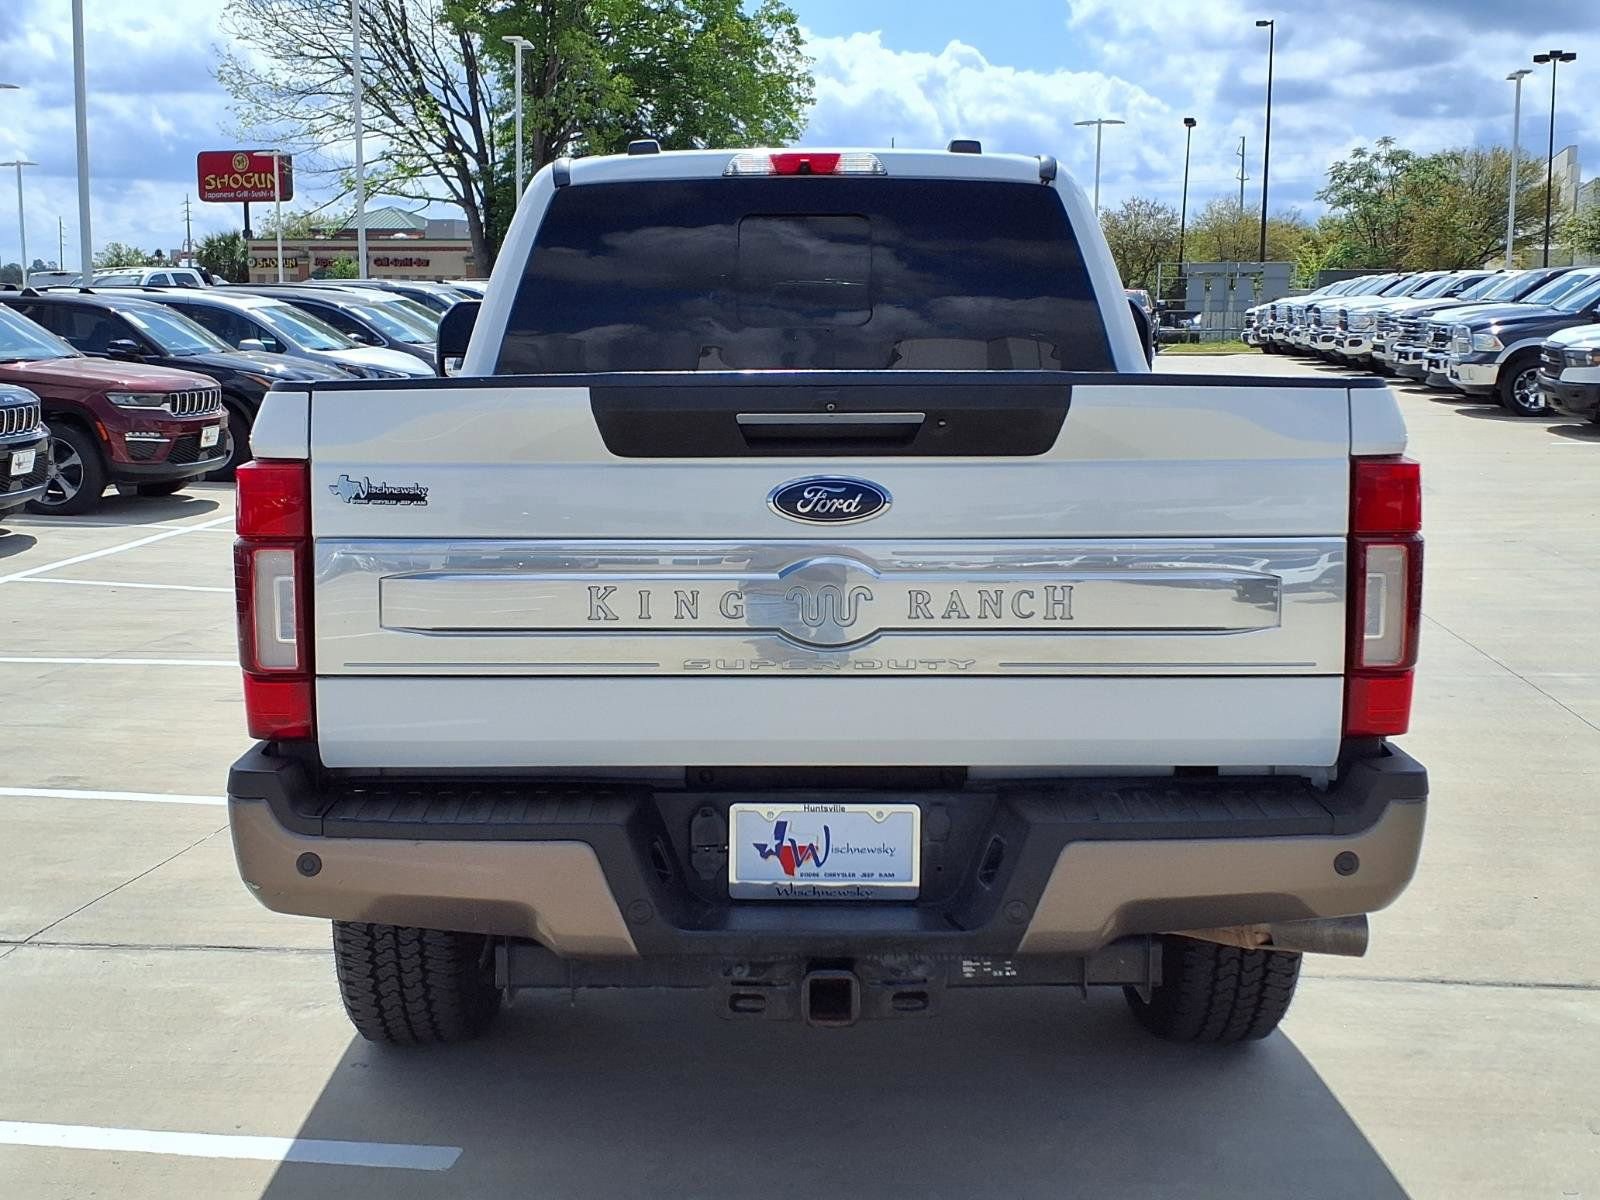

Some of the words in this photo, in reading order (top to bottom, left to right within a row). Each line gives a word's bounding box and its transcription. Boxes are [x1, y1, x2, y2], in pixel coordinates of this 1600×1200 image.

[205, 172, 277, 190] SHOGUN
[205, 191, 235, 199] Japanese
[256, 257, 298, 269] SHOUN
[796, 485, 863, 513] Ford
[587, 586, 745, 620] KING
[908, 585, 1074, 620] RANCH
[683, 659, 841, 671] SUPER
[854, 659, 977, 671] DUTY
[803, 804, 846, 814] Huntsville
[788, 825, 896, 868] Wischnewsky
[775, 882, 873, 898] Wischnewsky
